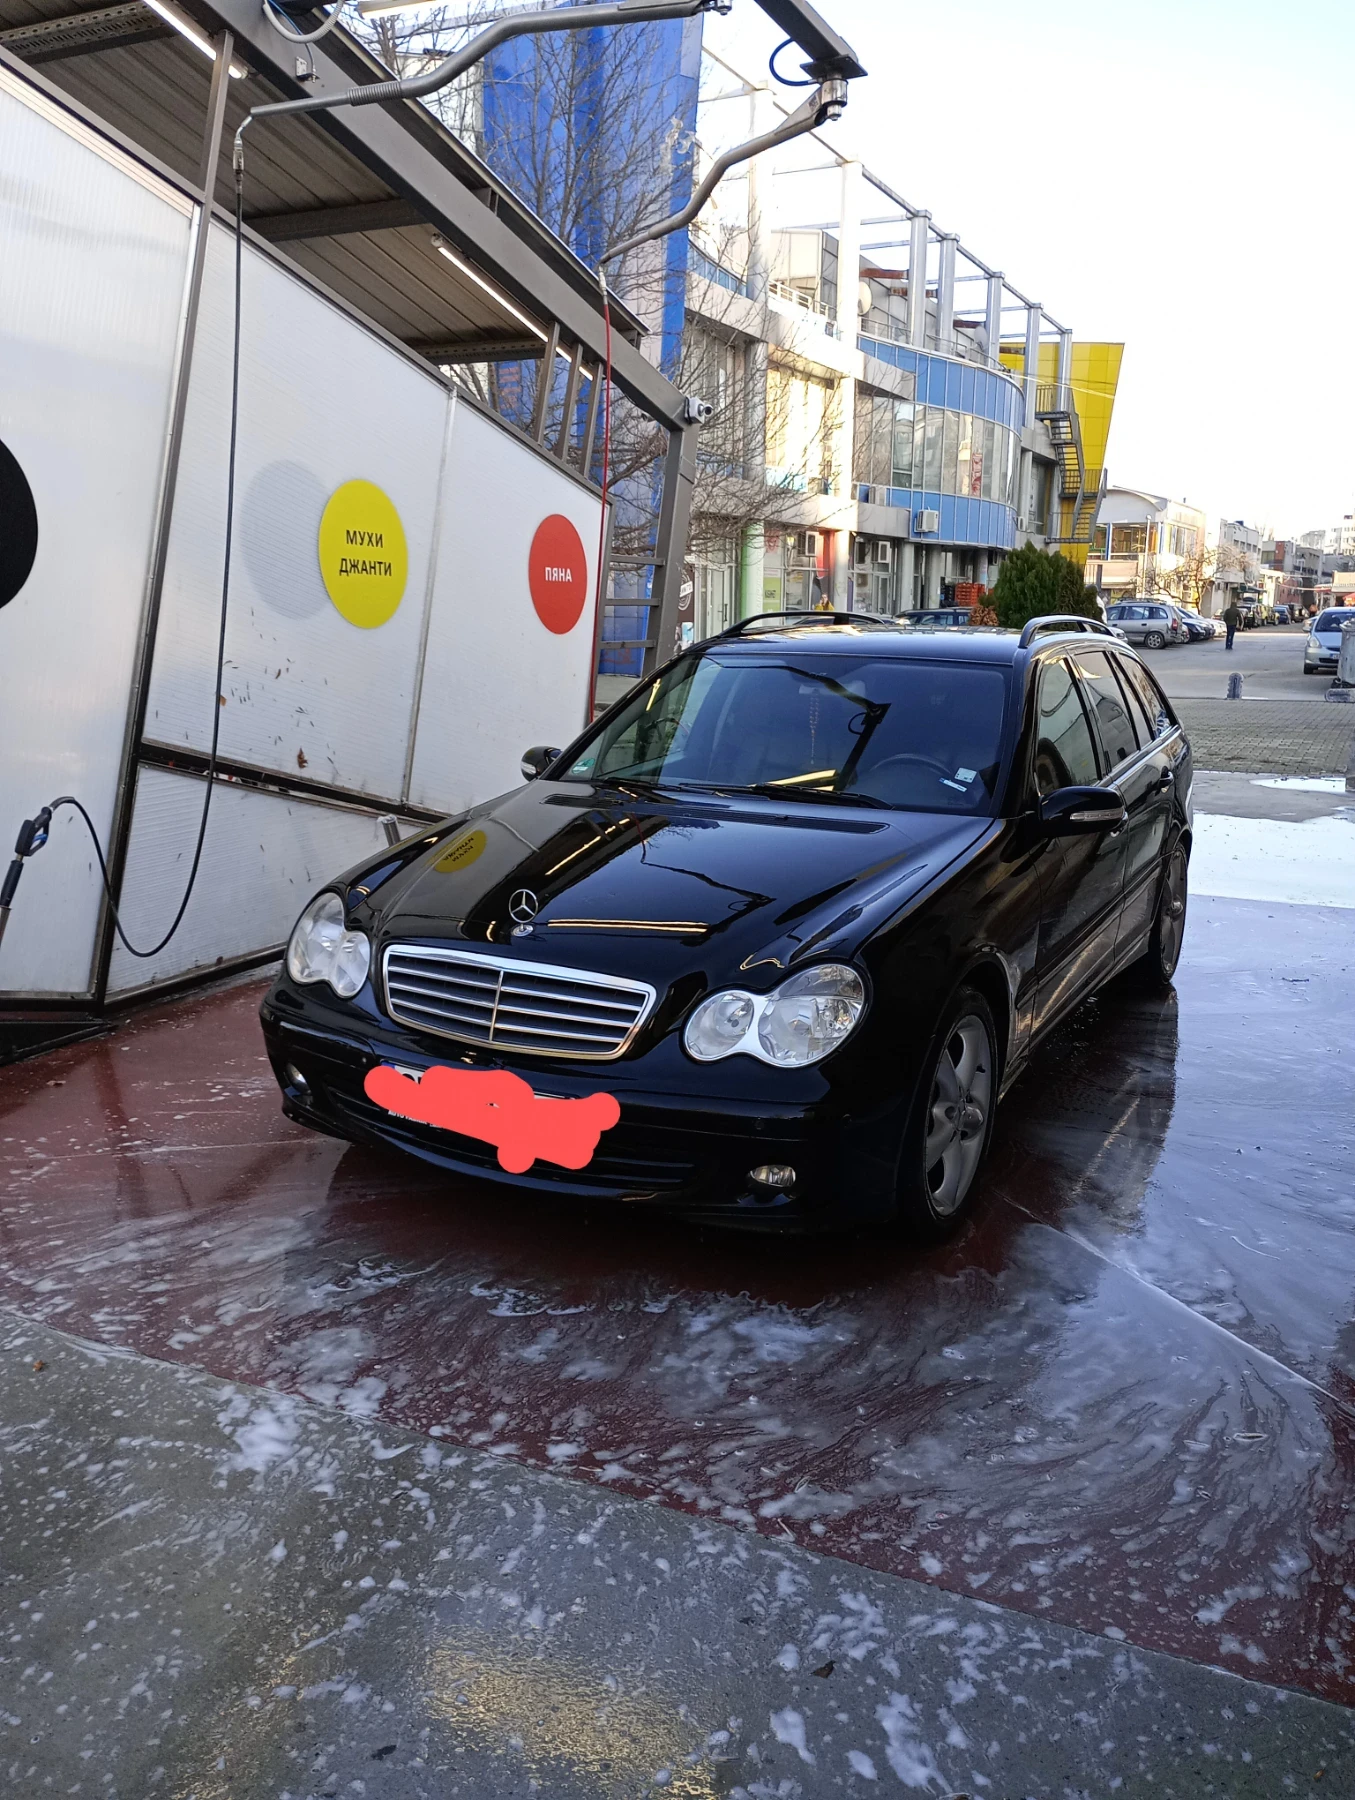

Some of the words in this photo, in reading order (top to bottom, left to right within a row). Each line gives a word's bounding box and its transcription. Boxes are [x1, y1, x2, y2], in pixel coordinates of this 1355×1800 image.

[346, 529, 384, 548] МУХИ
[339, 558, 392, 577] ДЖАНТИ
[545, 566, 573, 582] ПЯНА
